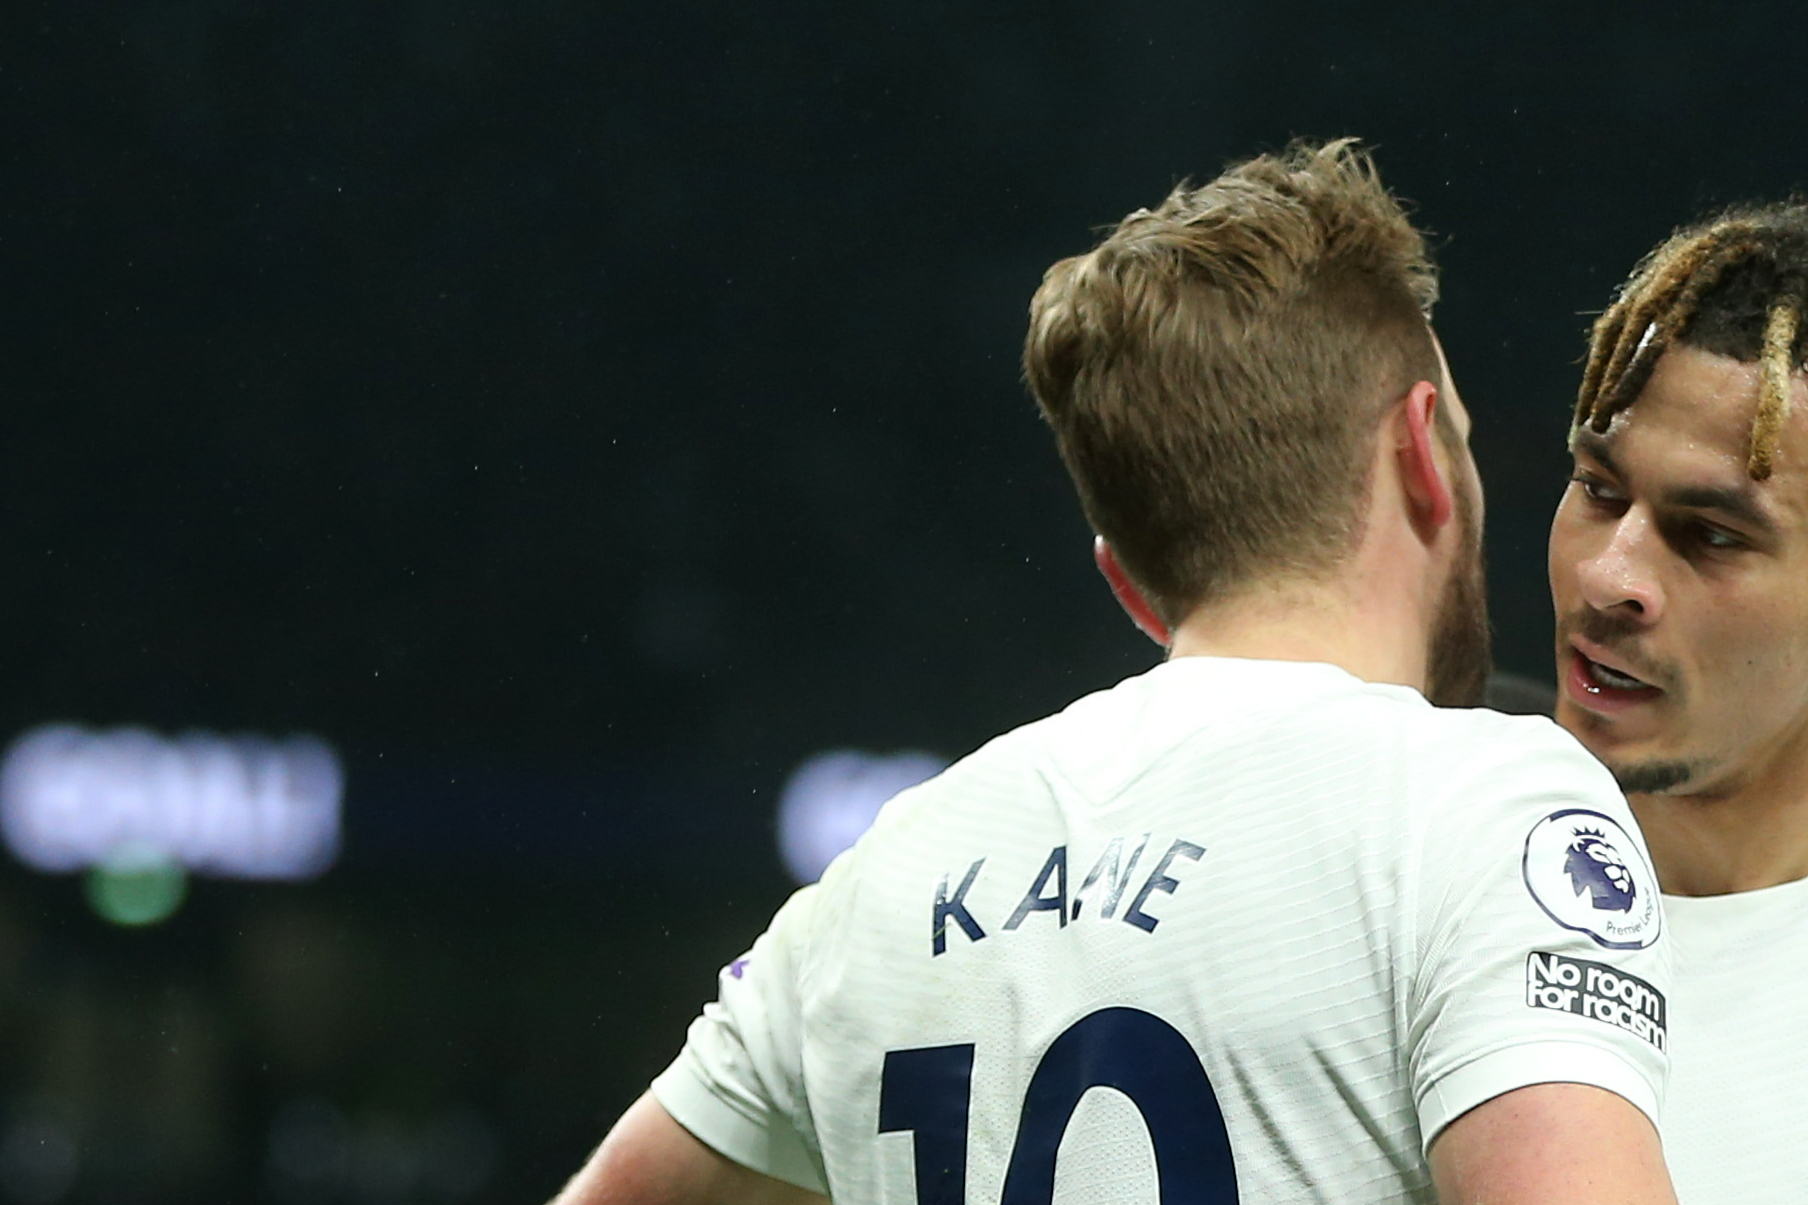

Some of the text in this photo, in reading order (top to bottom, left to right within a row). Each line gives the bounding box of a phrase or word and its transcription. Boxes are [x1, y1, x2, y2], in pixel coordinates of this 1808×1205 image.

[931, 832, 1207, 957] KANE
[1606, 920, 1643, 936] Premier
[1527, 979, 1667, 1054] for racism
[1528, 953, 1660, 1022] No room
